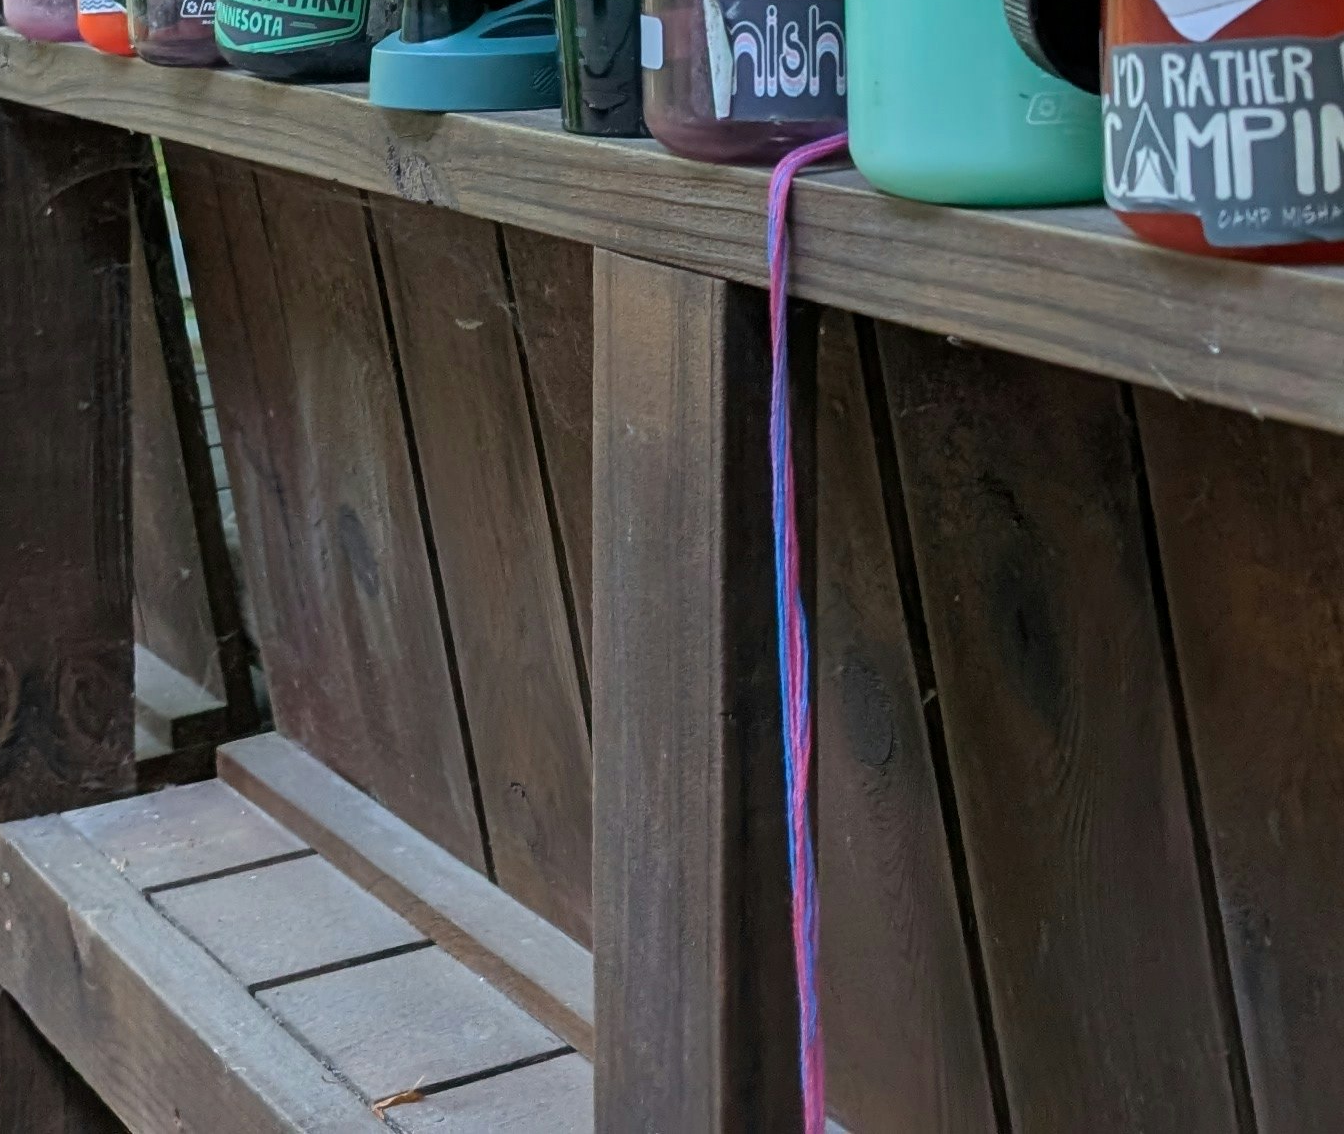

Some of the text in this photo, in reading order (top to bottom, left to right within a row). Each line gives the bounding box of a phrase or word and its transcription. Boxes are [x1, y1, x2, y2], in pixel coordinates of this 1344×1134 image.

[1112, 53, 1144, 109] I'D
[1161, 46, 1314, 109] RATHER
[1217, 206, 1272, 230] CAMP
